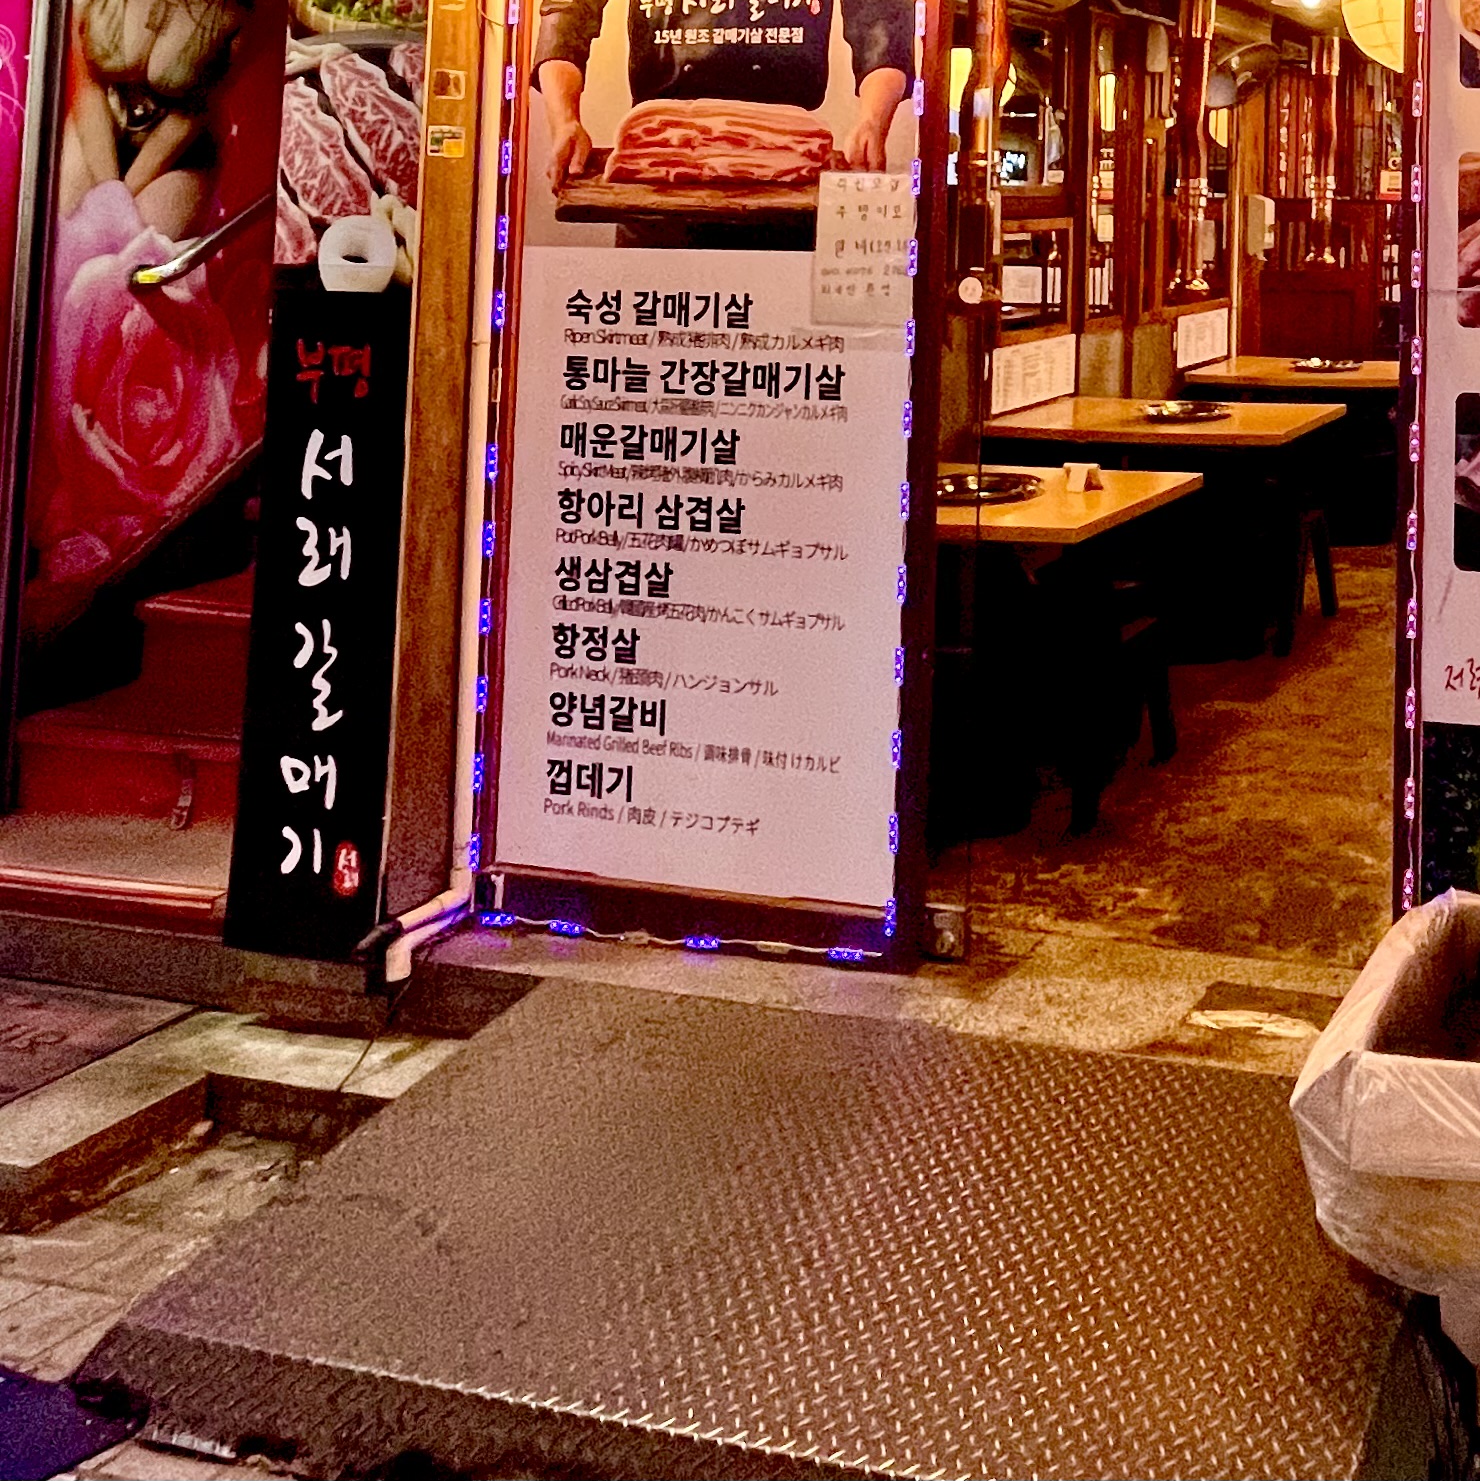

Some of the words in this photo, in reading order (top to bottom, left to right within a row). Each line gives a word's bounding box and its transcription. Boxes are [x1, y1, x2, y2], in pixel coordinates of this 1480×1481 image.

[653, 27, 682, 45] 15년
[685, 27, 710, 44] 원조
[712, 27, 763, 44] 갈매기살
[765, 25, 805, 45] 전문점
[565, 288, 623, 326] 숙성
[632, 290, 754, 330] 갈매기살
[295, 338, 373, 404] 부평
[562, 355, 651, 394] 통마늘
[659, 359, 847, 402] 간장갈매기살
[560, 422, 741, 466] 매운갈매기살
[557, 487, 644, 529] 항아리
[654, 494, 746, 535] 삼겹살
[554, 555, 674, 599] 생삼겹살
[551, 622, 641, 665] 항정살
[549, 691, 667, 737] 양념갈비
[545, 759, 634, 803] 껍데기
